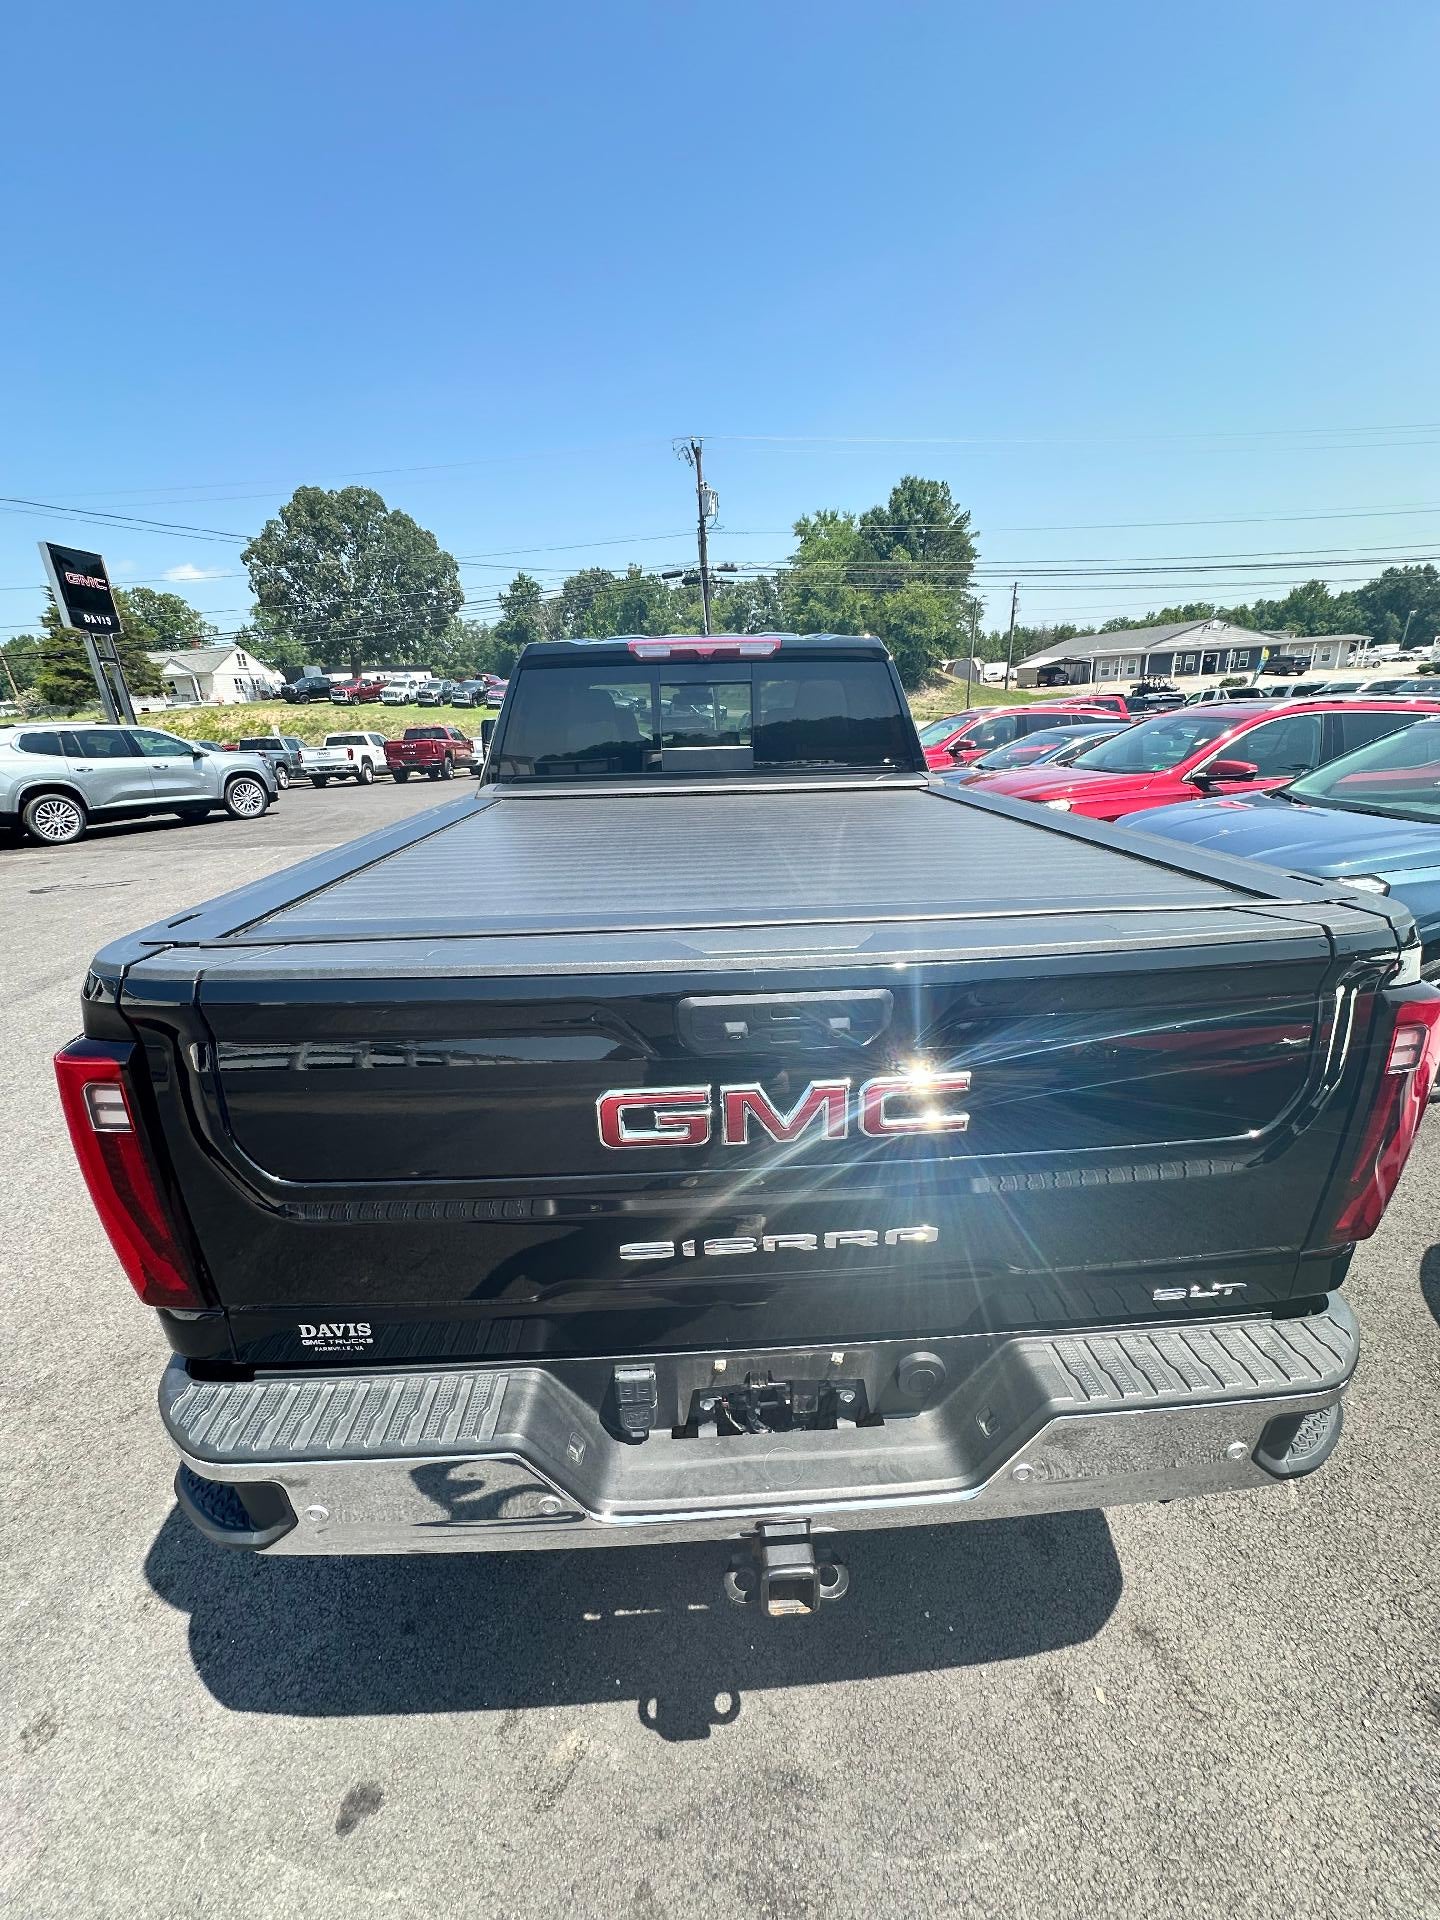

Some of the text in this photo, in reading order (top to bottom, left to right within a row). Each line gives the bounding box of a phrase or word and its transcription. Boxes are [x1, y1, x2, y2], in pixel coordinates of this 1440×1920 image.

[65, 571, 107, 590] GMC
[83, 613, 112, 626] DAVIS
[596, 1070, 972, 1149] GMC
[619, 1225, 940, 1261] SIERRA
[1152, 1282, 1247, 1300] SLT
[298, 1322, 372, 1338] DAVIS
